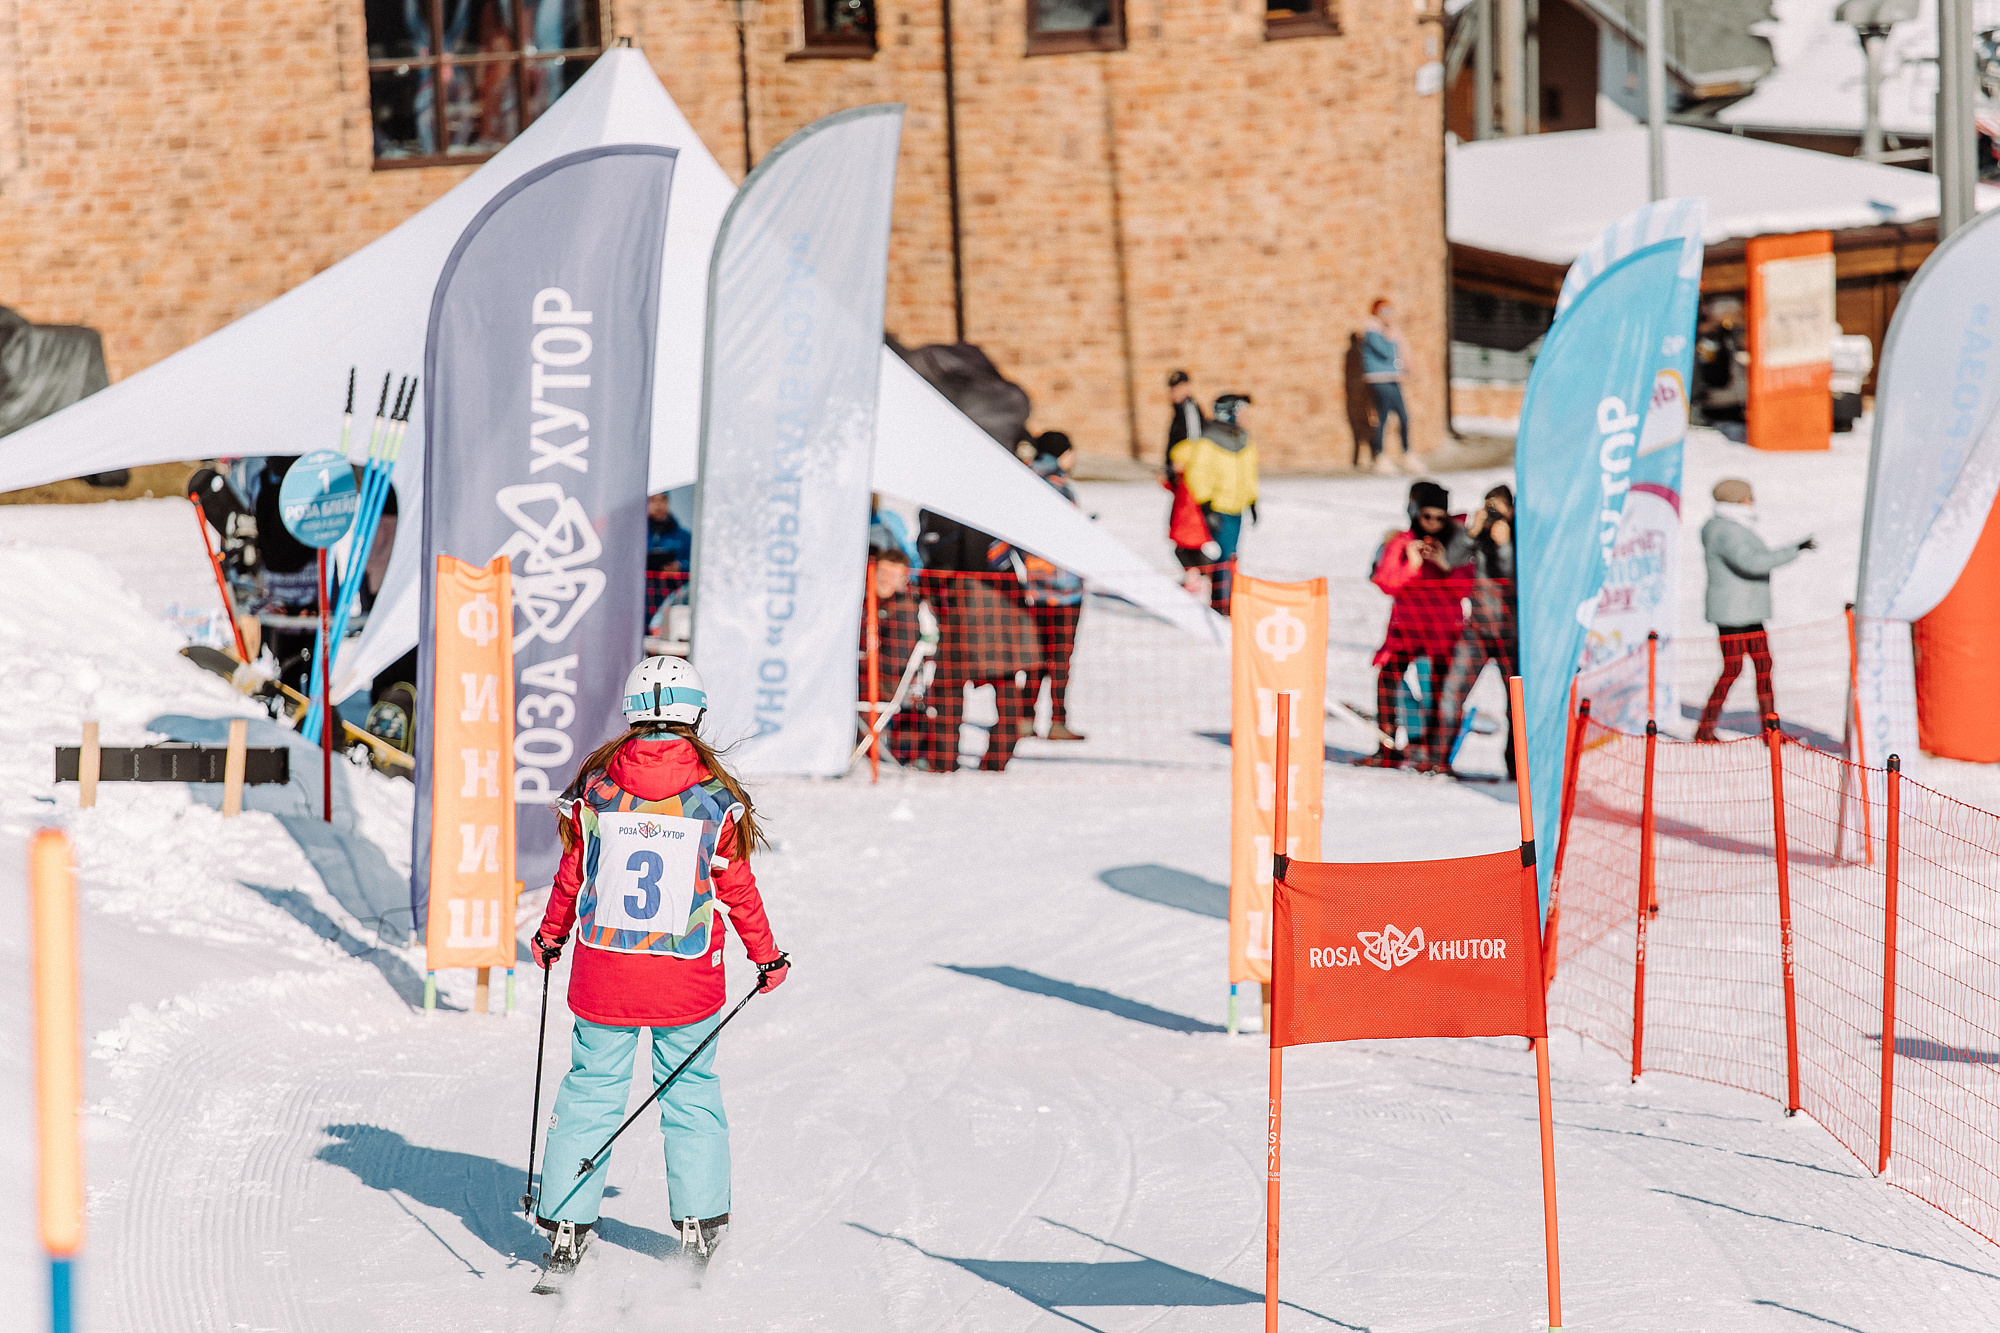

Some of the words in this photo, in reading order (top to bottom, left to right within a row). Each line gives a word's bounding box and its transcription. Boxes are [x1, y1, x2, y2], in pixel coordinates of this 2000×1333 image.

[530, 287, 593, 474] ХУТОР
[317, 468, 330, 494] 1
[514, 654, 580, 804] РОЗА
[446, 592, 500, 949] ФИНИШ
[618, 826, 638, 836] РОЗА
[662, 829, 685, 840] ХУТОР
[623, 850, 664, 920] 3
[1309, 946, 1361, 968] ROSA
[1428, 938, 1507, 961] KHUTOR
[1268, 1104, 1278, 1171] LISKI
